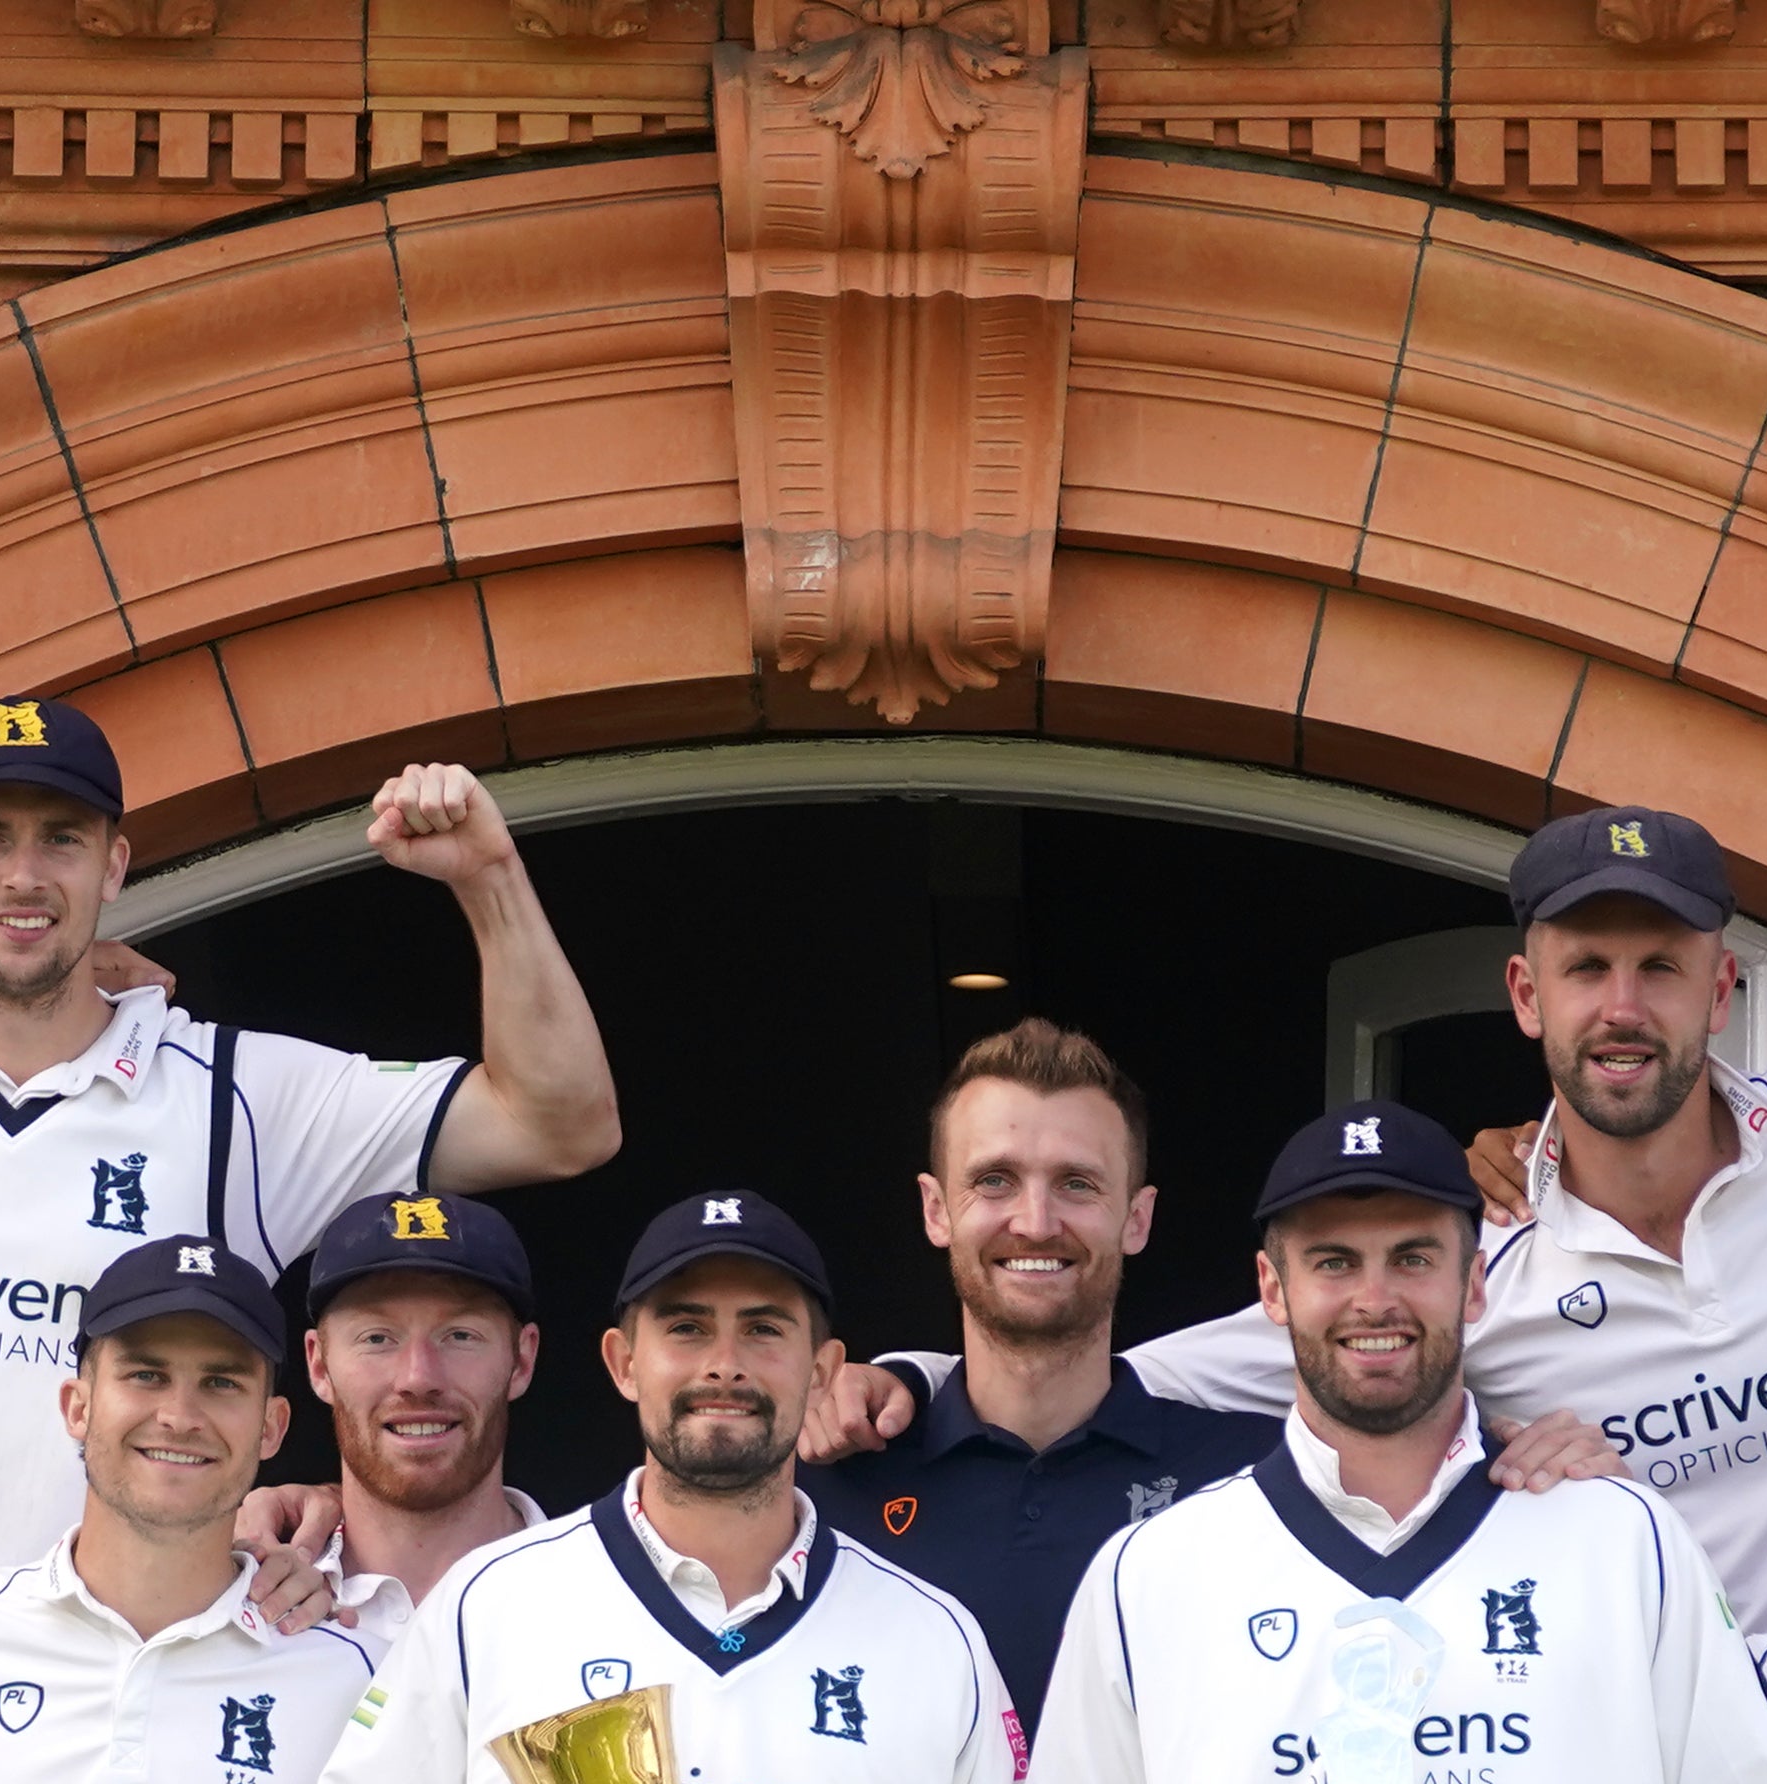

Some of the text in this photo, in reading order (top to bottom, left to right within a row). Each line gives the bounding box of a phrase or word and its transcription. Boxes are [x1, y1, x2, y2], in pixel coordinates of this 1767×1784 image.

[1727, 1087, 1754, 1109] SIGNS
[1566, 1292, 1588, 1310] PL
[1258, 1617, 1282, 1634] PL
[590, 1666, 615, 1679] PL
[3, 1690, 27, 1704] PL
